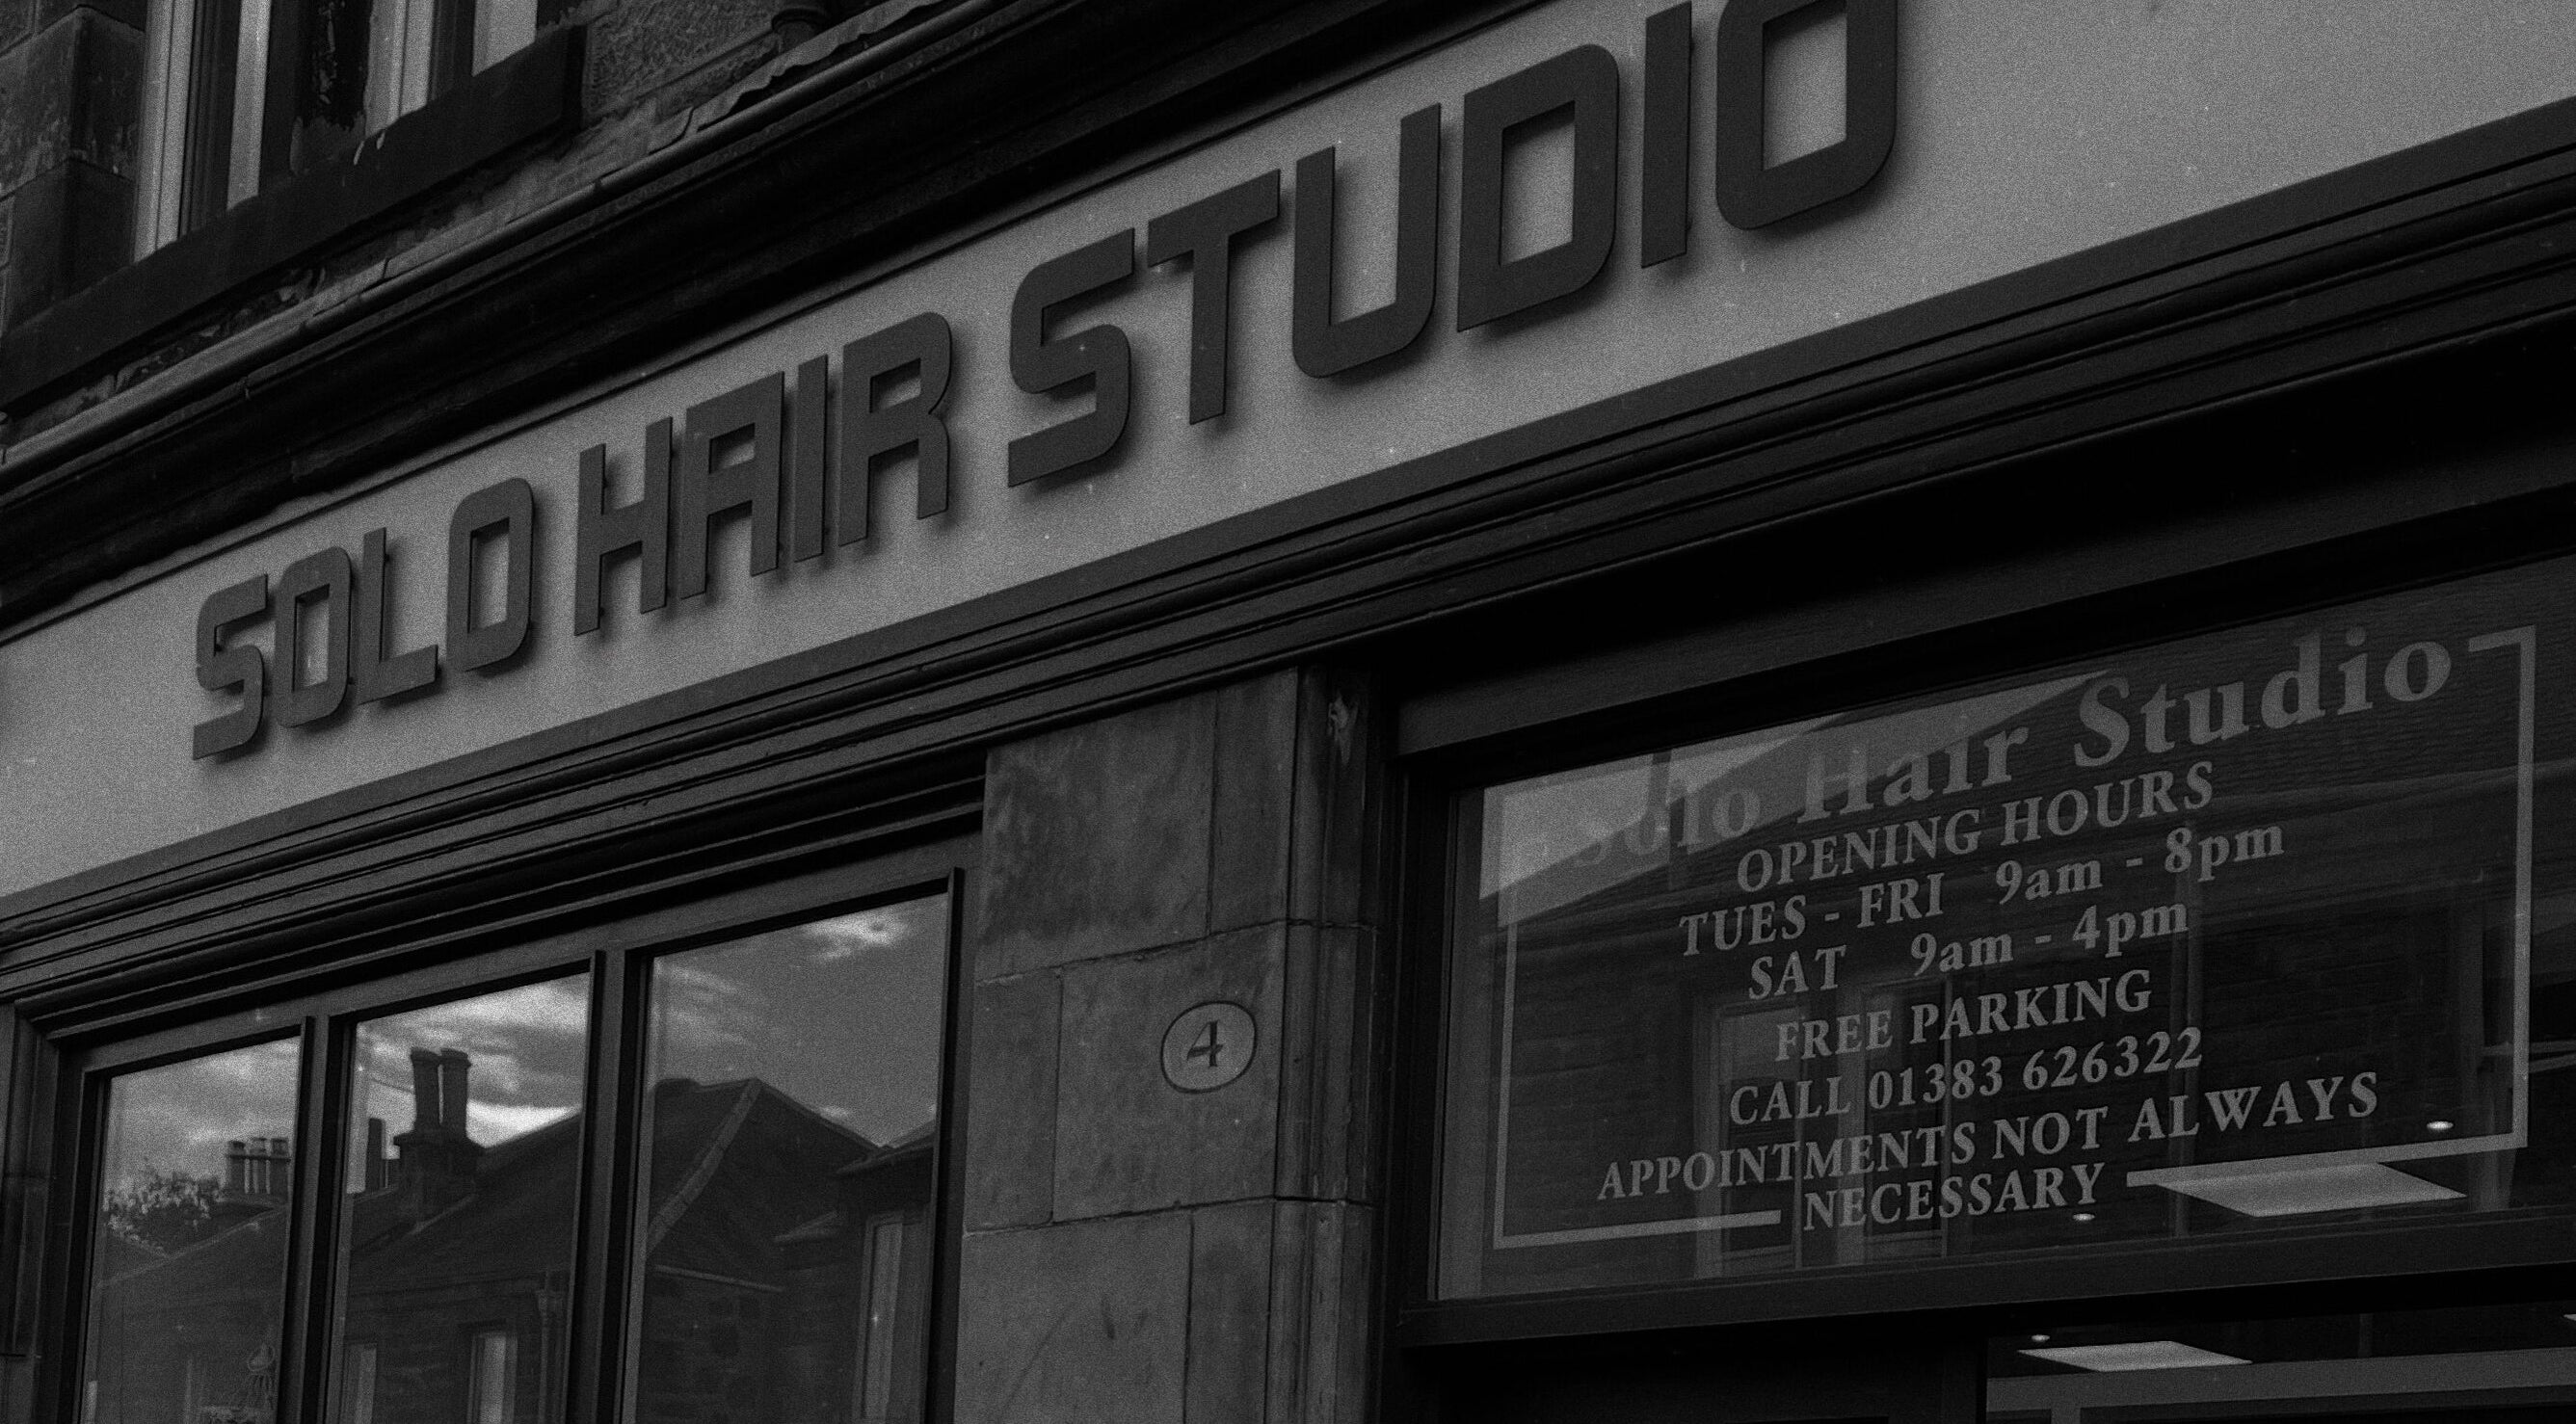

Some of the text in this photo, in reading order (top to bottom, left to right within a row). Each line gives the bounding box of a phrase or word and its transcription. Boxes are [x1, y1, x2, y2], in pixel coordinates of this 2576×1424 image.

[193, 0, 1898, 760] SOLO HAIR STUDIO
[1797, 722, 2030, 825] Hair
[2073, 627, 2451, 768] Studio
[1736, 761, 2216, 894] OPENING HOURS
[1679, 894, 1807, 958] TUES
[1857, 872, 1946, 931] FRI
[1995, 859, 2105, 909] 9am
[2164, 824, 2284, 883] 8pm
[1748, 944, 1846, 1002] SAT
[1908, 931, 2014, 978] 9am
[2071, 901, 2189, 959] 4pm
[1186, 1019, 1224, 1068] 4
[1774, 969, 2152, 1063] FREE PARKING
[1730, 1027, 2204, 1125] CALL 01383 626322
[1597, 1071, 2379, 1200] APPOINTMENTS NOT ALWAYS
[1803, 1162, 2105, 1231] NECESSARY
